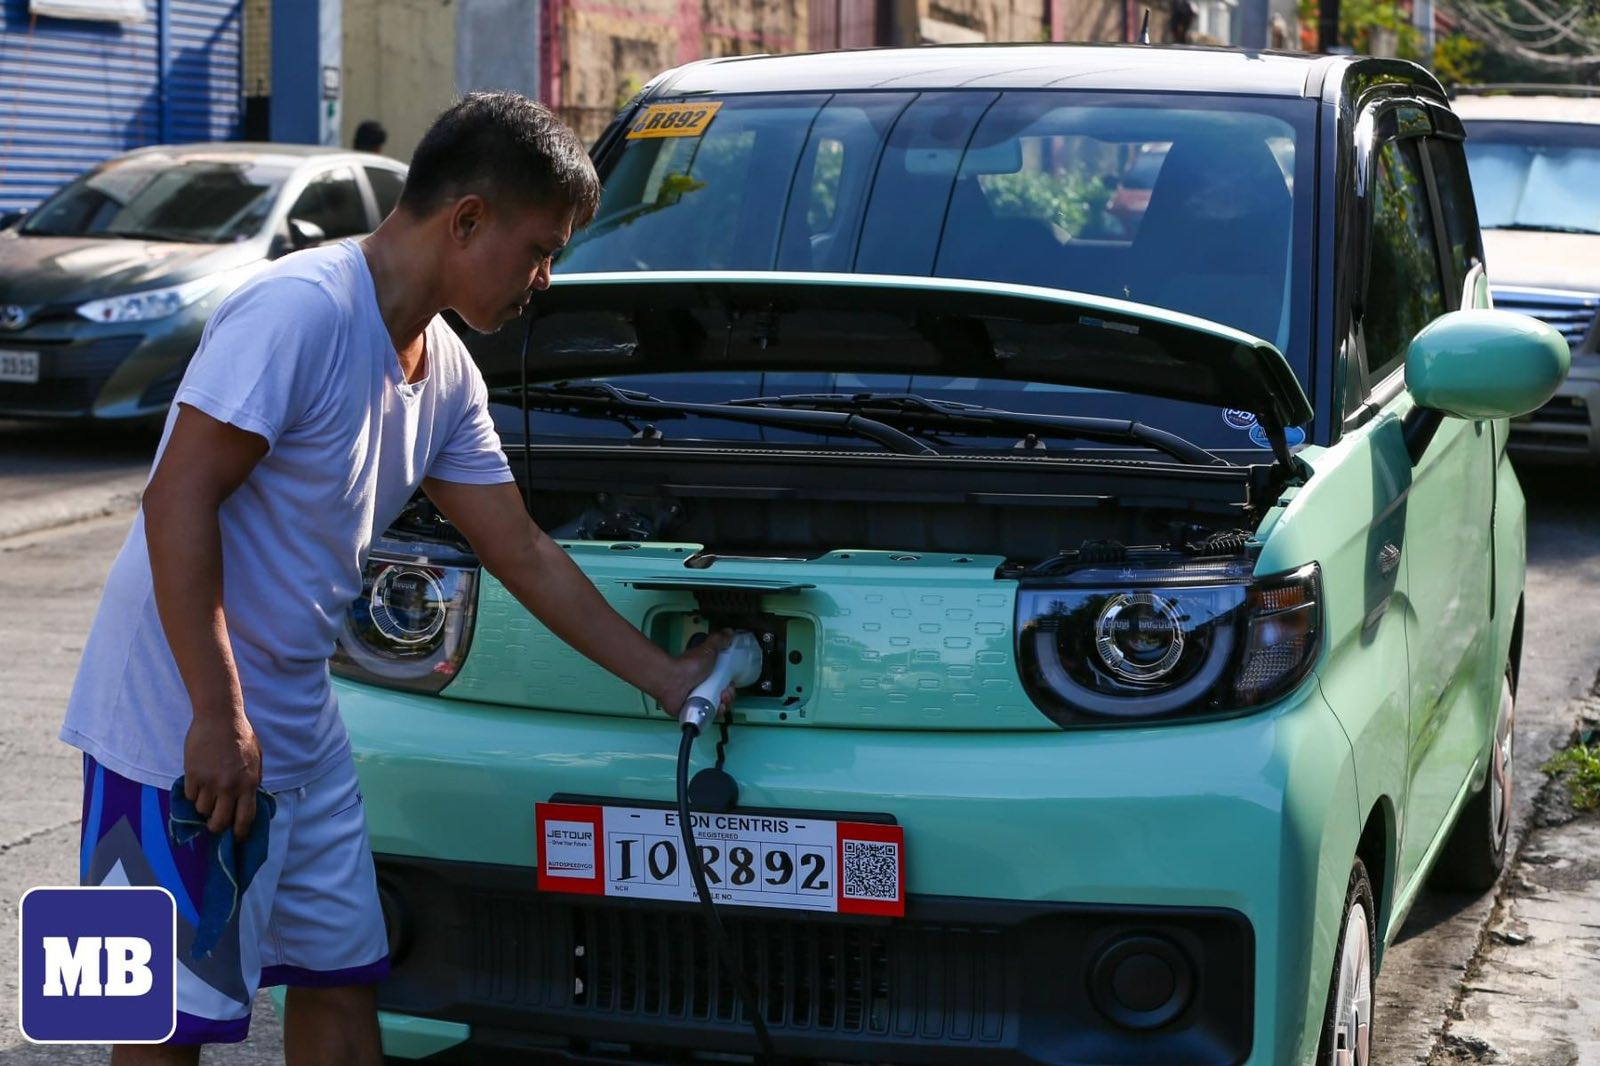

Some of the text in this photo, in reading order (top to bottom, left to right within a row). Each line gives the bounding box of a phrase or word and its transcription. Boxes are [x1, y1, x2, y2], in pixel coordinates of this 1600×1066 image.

[646, 109, 707, 129] R892
[715, 816, 789, 834] CENTRIS
[546, 830, 592, 840] JETOUR
[698, 831, 738, 840] REGISTERED
